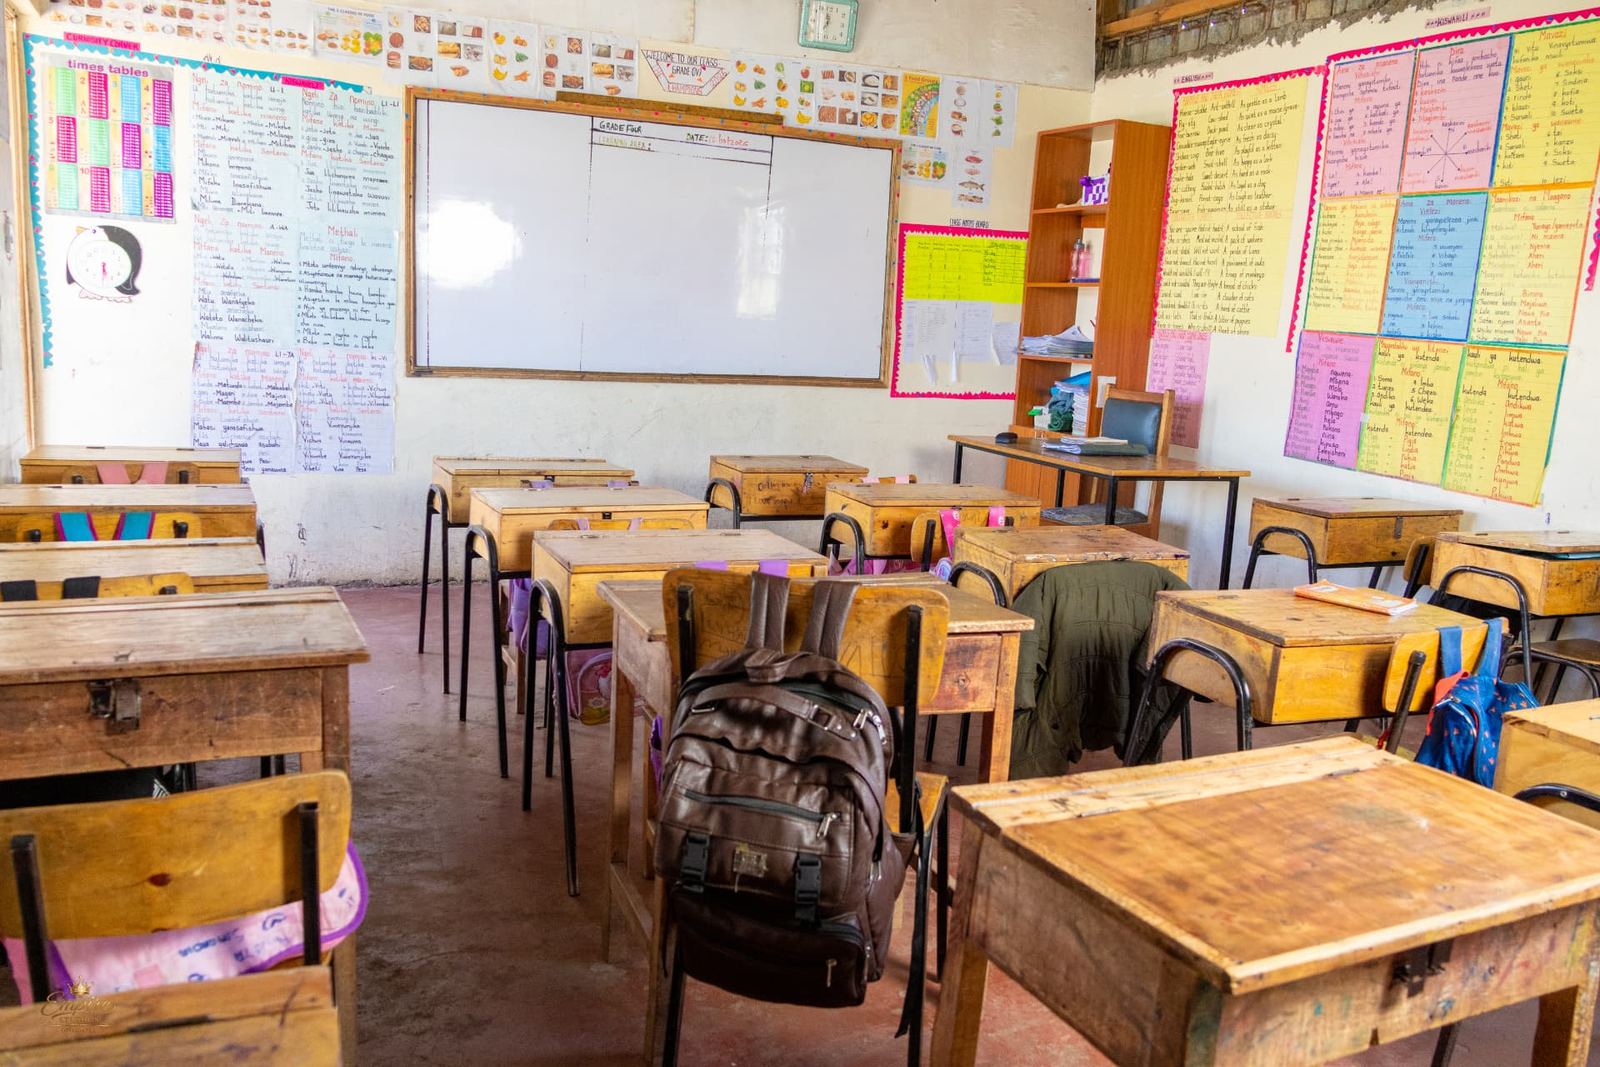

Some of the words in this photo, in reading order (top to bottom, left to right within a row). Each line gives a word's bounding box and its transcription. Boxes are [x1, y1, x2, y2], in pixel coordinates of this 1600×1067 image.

[68, 60, 104, 73] times
[109, 64, 149, 78] tables
[600, 121, 625, 132] GRADE
